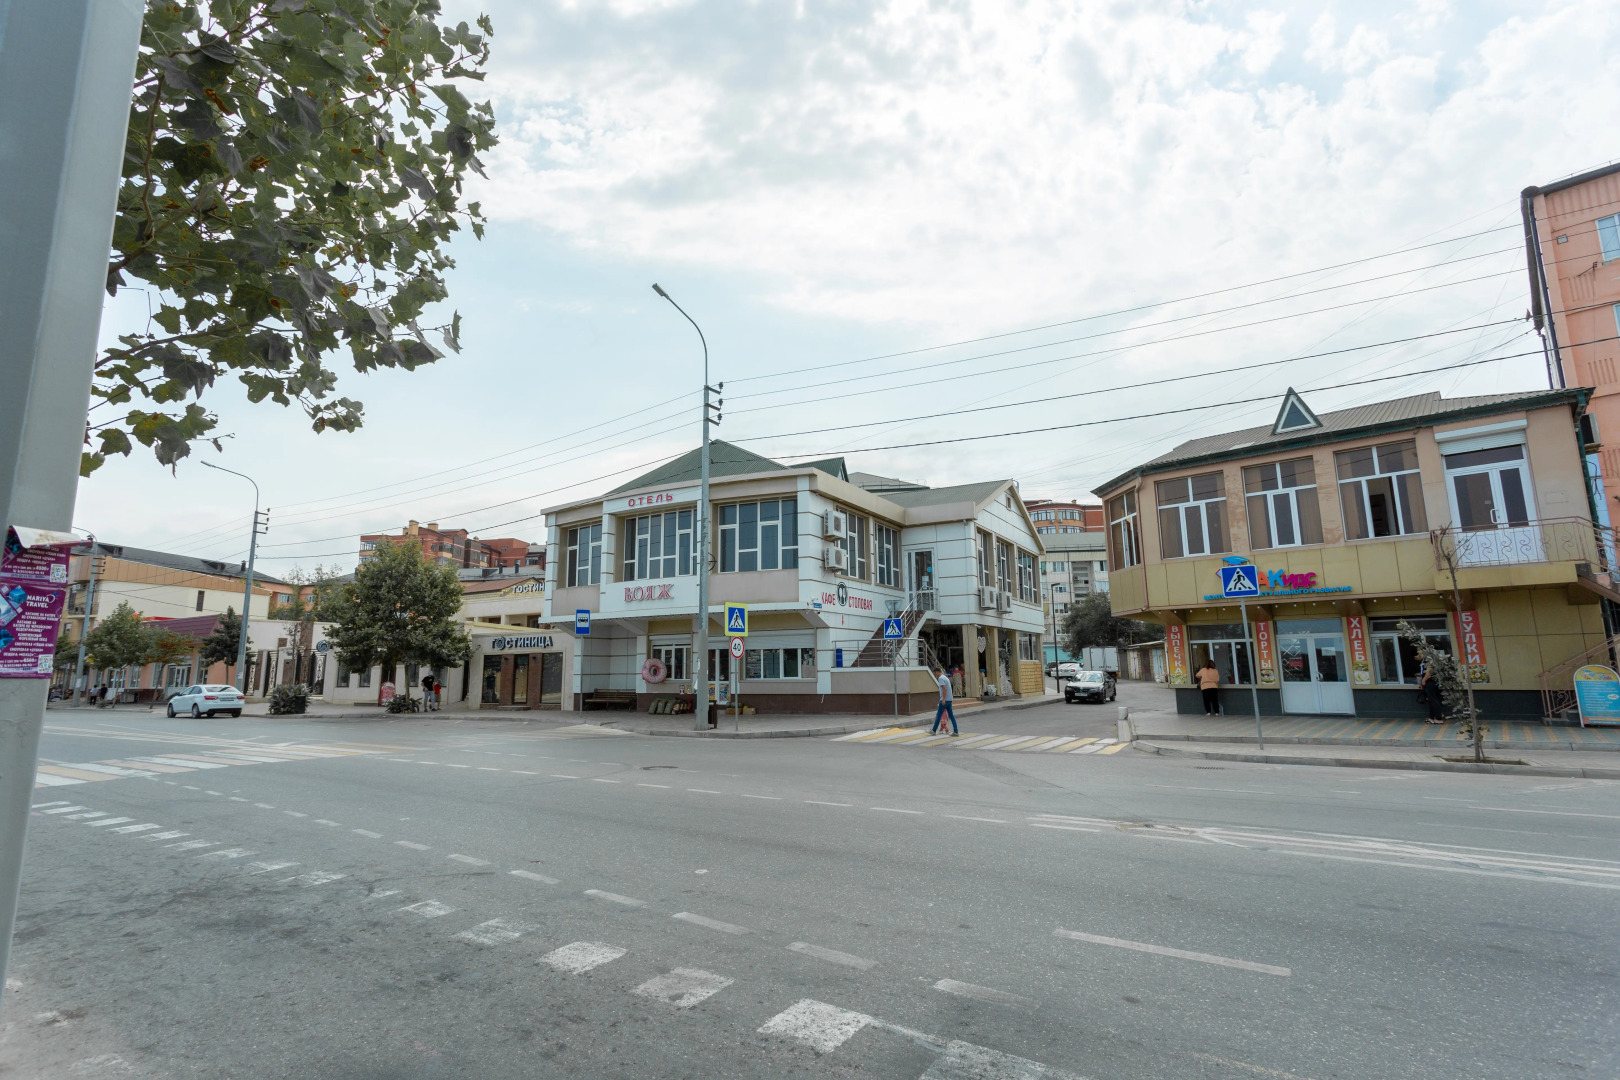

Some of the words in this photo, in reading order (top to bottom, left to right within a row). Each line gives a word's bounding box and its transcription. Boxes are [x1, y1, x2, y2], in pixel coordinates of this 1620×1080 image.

[628, 493, 673, 507] ОТЕЛЬ
[624, 584, 673, 602] ВОЯЖ
[1310, 586, 1352, 594] РАЗВИТИЯ
[26, 594, 49, 602] MARIYA
[26, 601, 49, 609] TRAVEL
[821, 592, 836, 606] КАФЕ
[491, 636, 553, 650] ГОСТИНИЦА
[1258, 622, 1271, 668] ТОРТЫ
[1350, 618, 1365, 661] ХЛЕБ
[1461, 612, 1480, 664] БУЛКИ
[733, 643, 742, 651] 40
[1170, 625, 1183, 674] ВЫПЕЧКА
